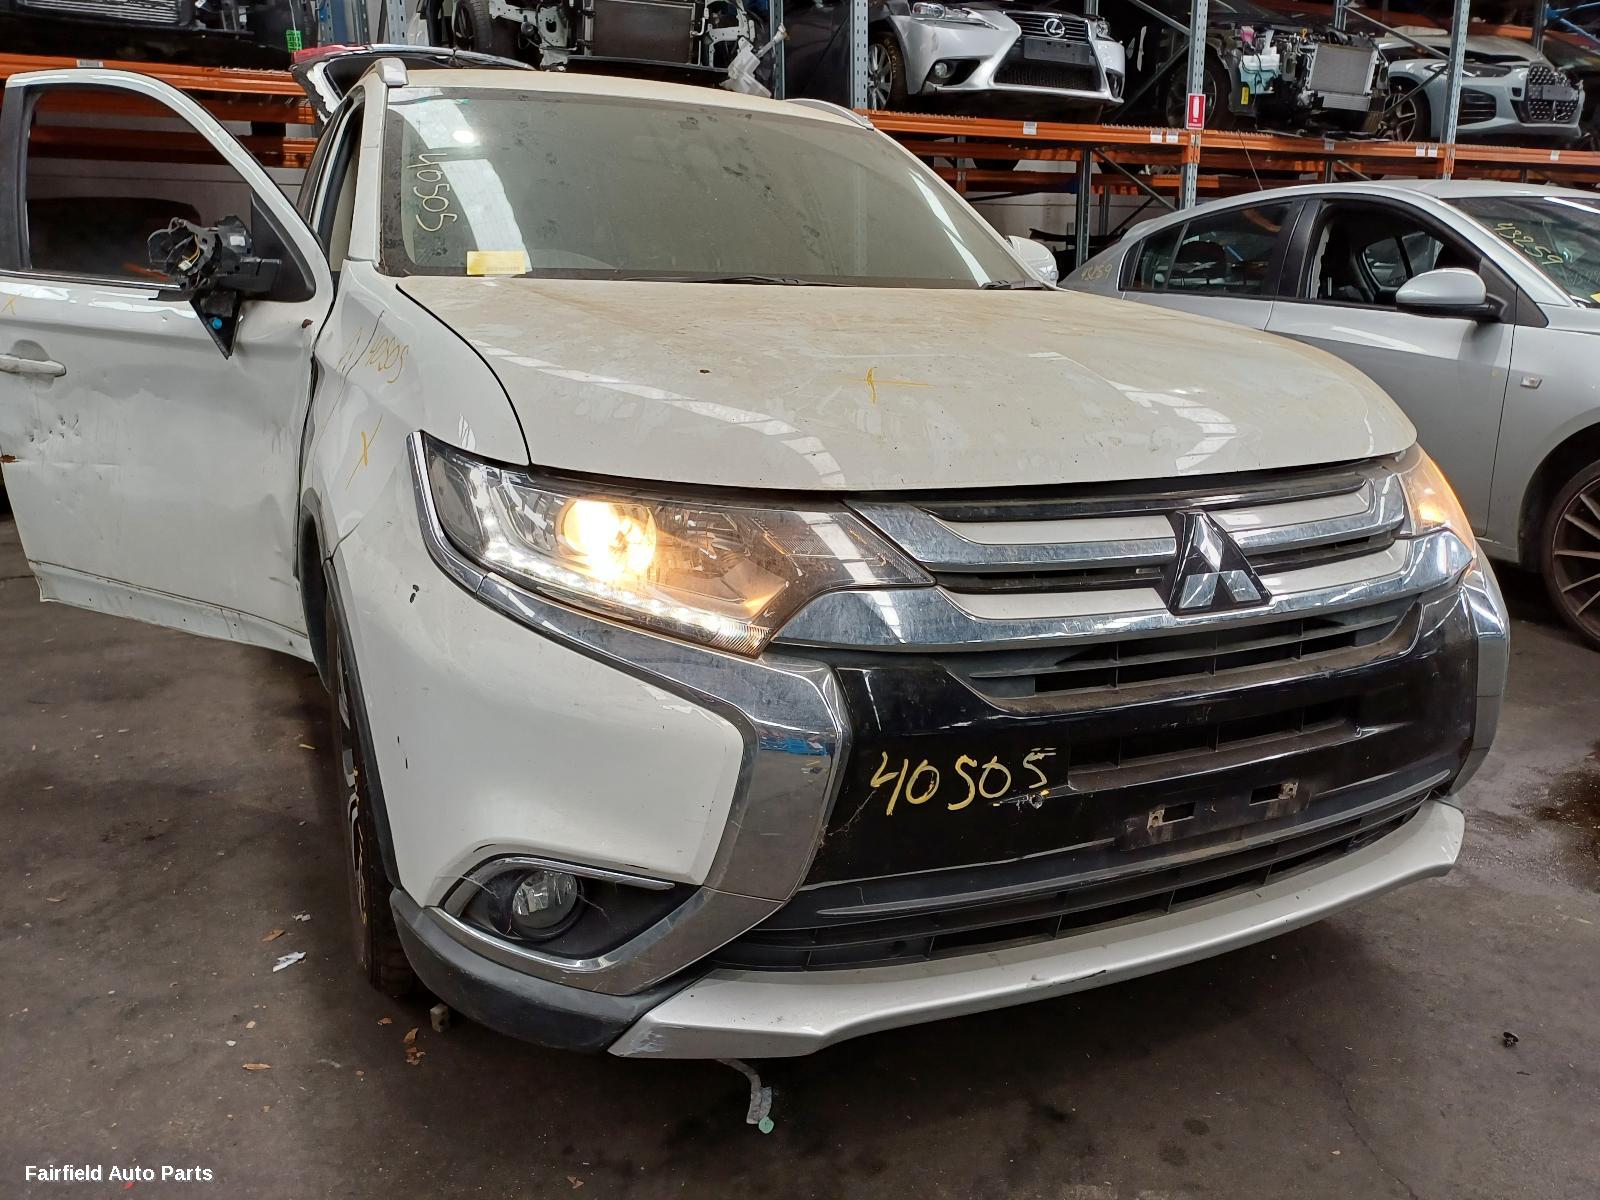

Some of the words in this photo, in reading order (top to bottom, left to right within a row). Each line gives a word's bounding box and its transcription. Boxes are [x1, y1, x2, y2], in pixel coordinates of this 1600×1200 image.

[407, 153, 458, 232] 40505
[1494, 222, 1563, 265] 43259
[870, 747, 1057, 816] 40505
